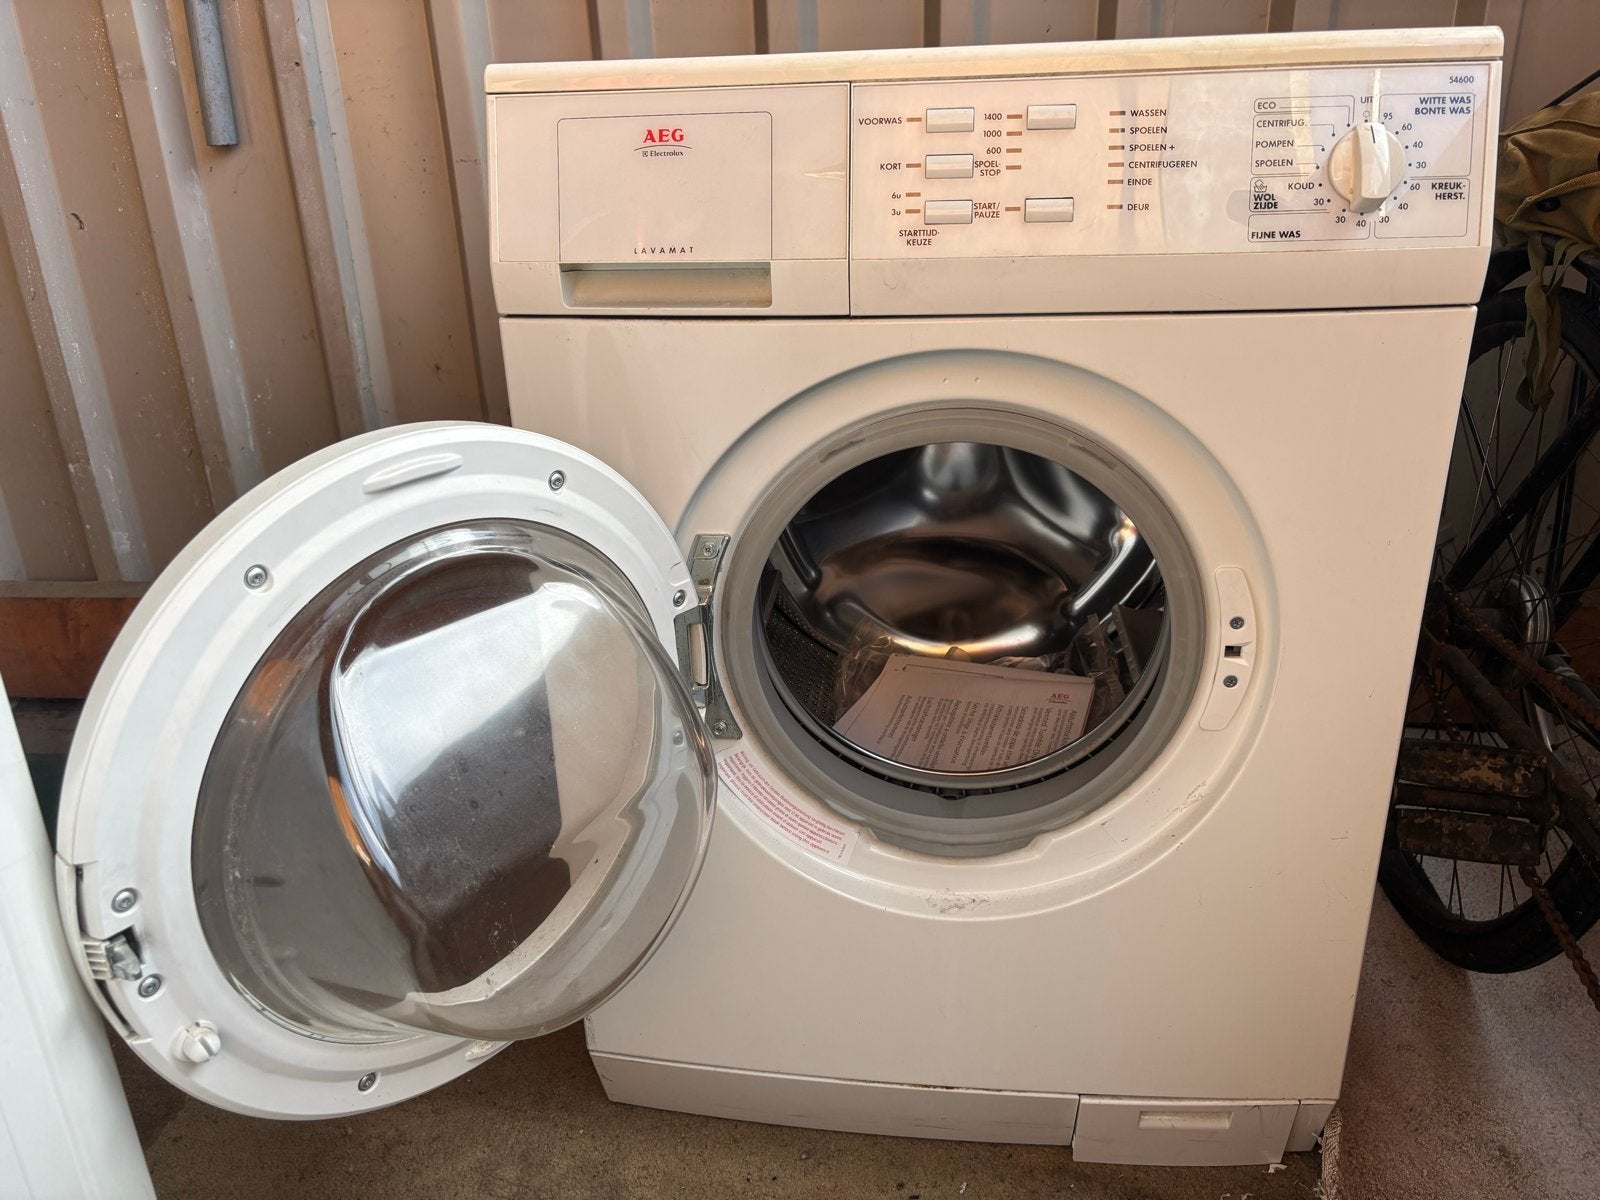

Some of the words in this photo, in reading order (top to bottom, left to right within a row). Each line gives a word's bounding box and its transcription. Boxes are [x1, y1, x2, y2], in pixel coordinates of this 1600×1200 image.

[1361, 96, 1373, 104] UIT
[1450, 96, 1471, 104] WAS
[1131, 109, 1167, 117] WASSEN
[1415, 107, 1446, 115] BONTE
[984, 113, 1002, 121] 1400
[859, 117, 902, 126] VOORWAS
[1130, 126, 1168, 134] SPOELEN
[1402, 123, 1412, 131] 60
[643, 129, 684, 143] AEG
[983, 130, 1002, 138] 1000
[1129, 143, 1166, 152] SPOELEN
[1256, 140, 1294, 148] POMPEN
[880, 162, 901, 171] KORT
[974, 160, 1001, 169] SPOEL-
[1128, 160, 1197, 169] CENTRIFUGEREN
[1255, 159, 1293, 167] SPOELEN
[1416, 161, 1426, 169] 30
[980, 169, 1001, 177] STOP
[1128, 178, 1152, 186] EINDE
[1431, 182, 1465, 190] KREUK-
[1254, 194, 1276, 202] WOL
[1435, 192, 1465, 200] HERST.
[1254, 202, 1278, 210] ZIJDE
[1314, 198, 1324, 206] 30
[974, 202, 1000, 211] START/
[1128, 203, 1149, 211] DEUR
[892, 208, 901, 216] 3u
[974, 211, 1000, 219] PAUZE
[1335, 216, 1345, 224] 30
[1379, 216, 1389, 224] 30
[899, 229, 940, 238] STARTTIJD-
[1252, 231, 1276, 239] FIJNE
[907, 238, 932, 246] KEUZE
[1014, 704, 1029, 730] Secadora
